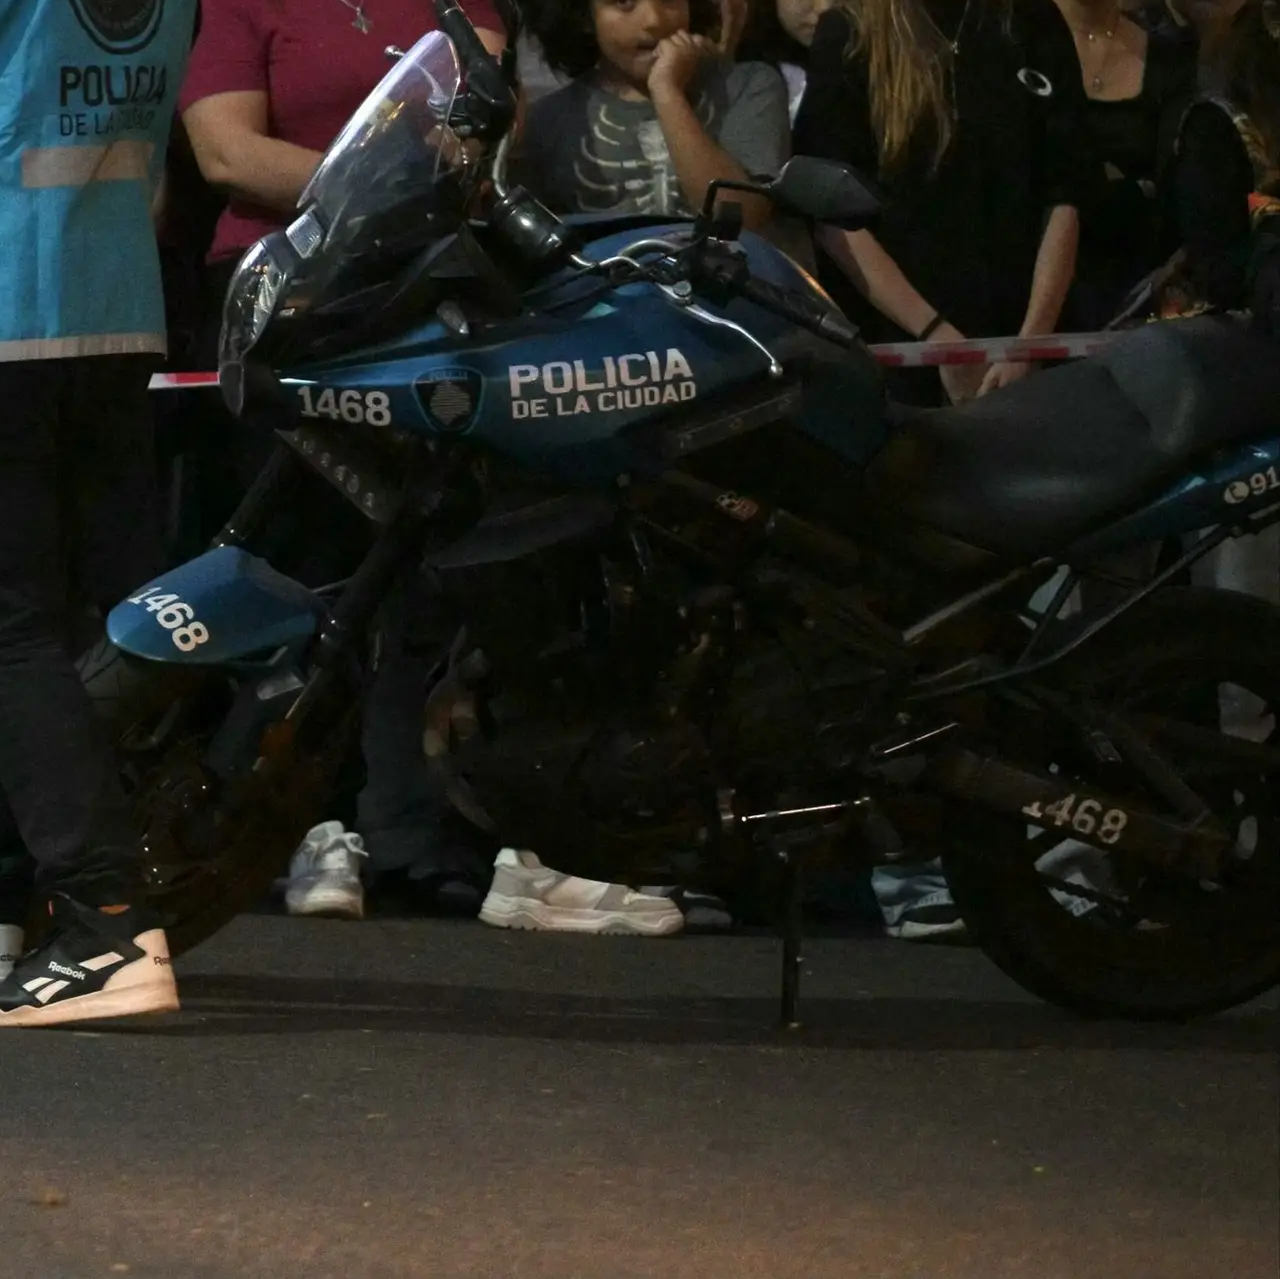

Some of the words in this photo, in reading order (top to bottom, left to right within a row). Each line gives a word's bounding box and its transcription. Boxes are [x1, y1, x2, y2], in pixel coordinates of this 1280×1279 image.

[59, 64, 167, 107] POLICIA
[59, 113, 88, 136] DE
[508, 348, 693, 398] POLICIA
[297, 386, 392, 426] 1468
[512, 399, 549, 419] DE
[556, 395, 591, 416] LA
[597, 381, 697, 411] CIUDAD
[126, 586, 210, 652] 1468
[47, 960, 86, 981] Reebok
